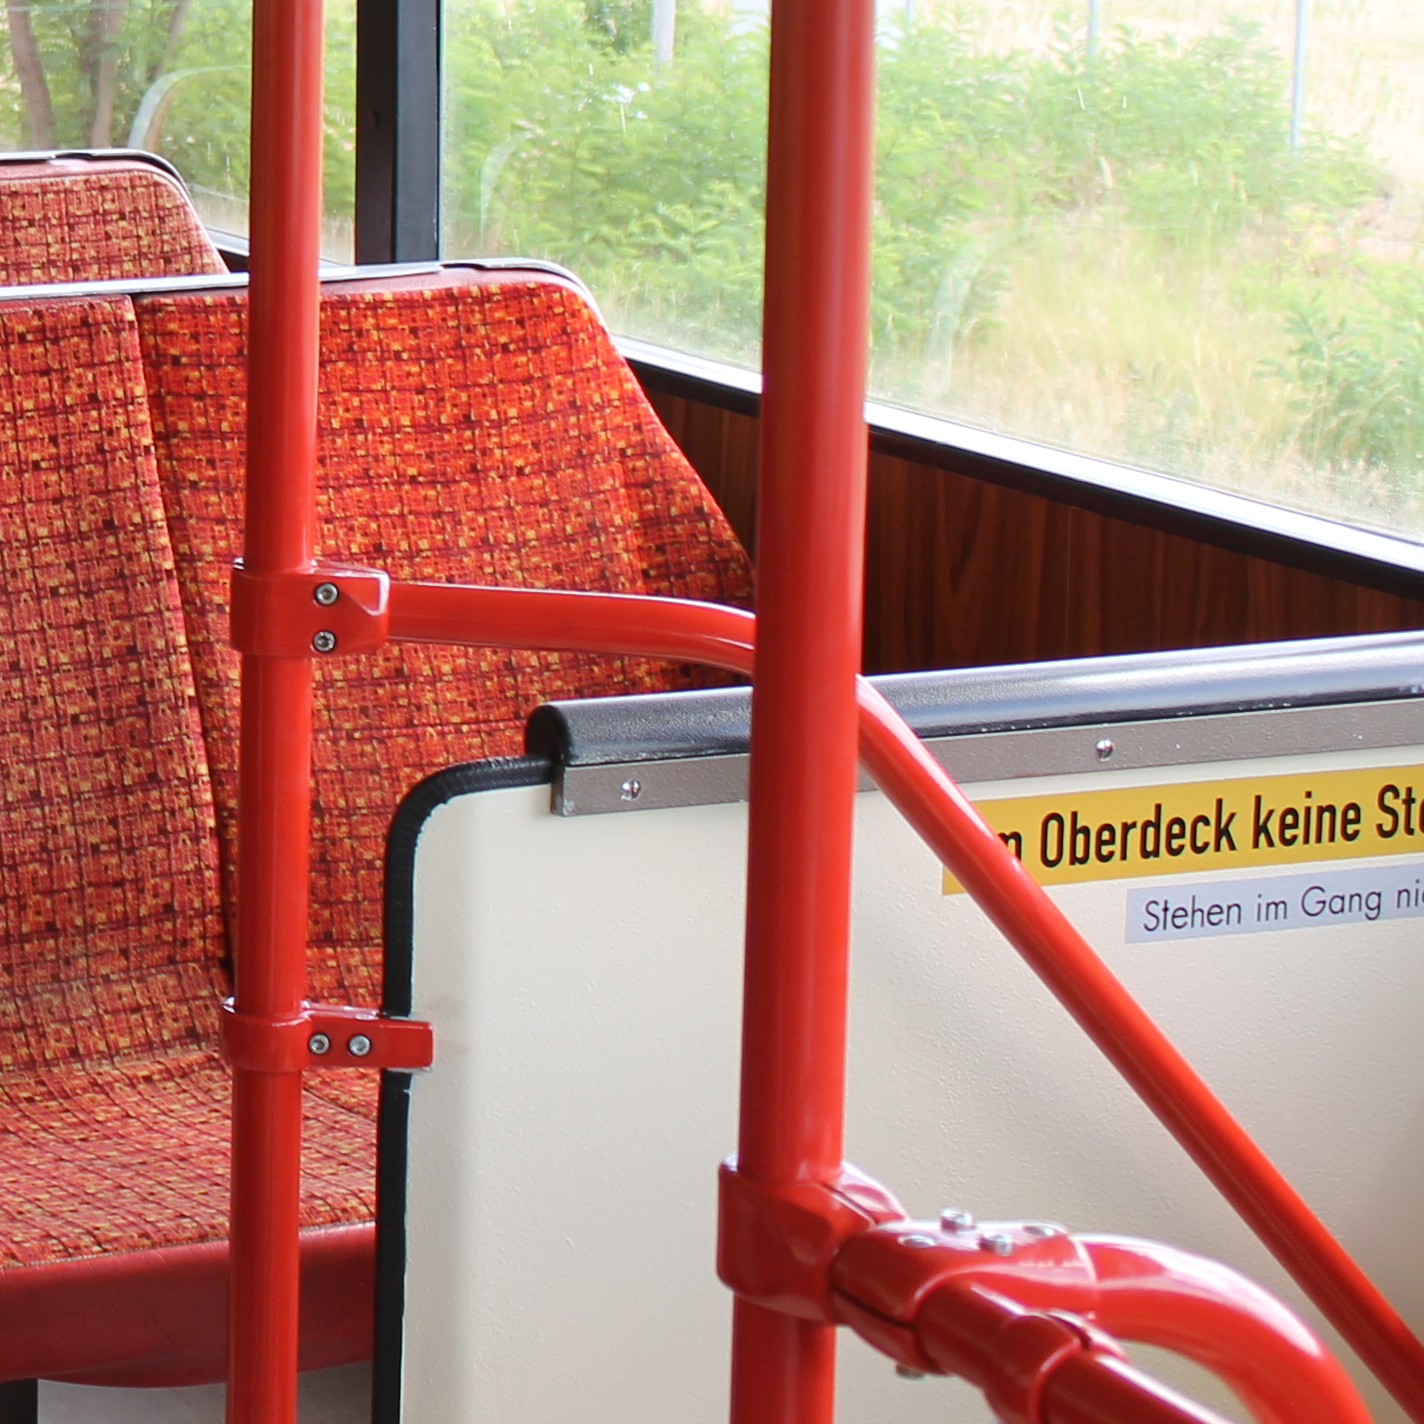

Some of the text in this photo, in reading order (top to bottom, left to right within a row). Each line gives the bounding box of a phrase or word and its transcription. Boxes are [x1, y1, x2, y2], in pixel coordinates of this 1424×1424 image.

[1040, 798, 1238, 868] Oberdeck
[1252, 790, 1362, 850] keine
[1375, 783, 1424, 839] St
[1143, 879, 1424, 932] Stehen im Gang ni
